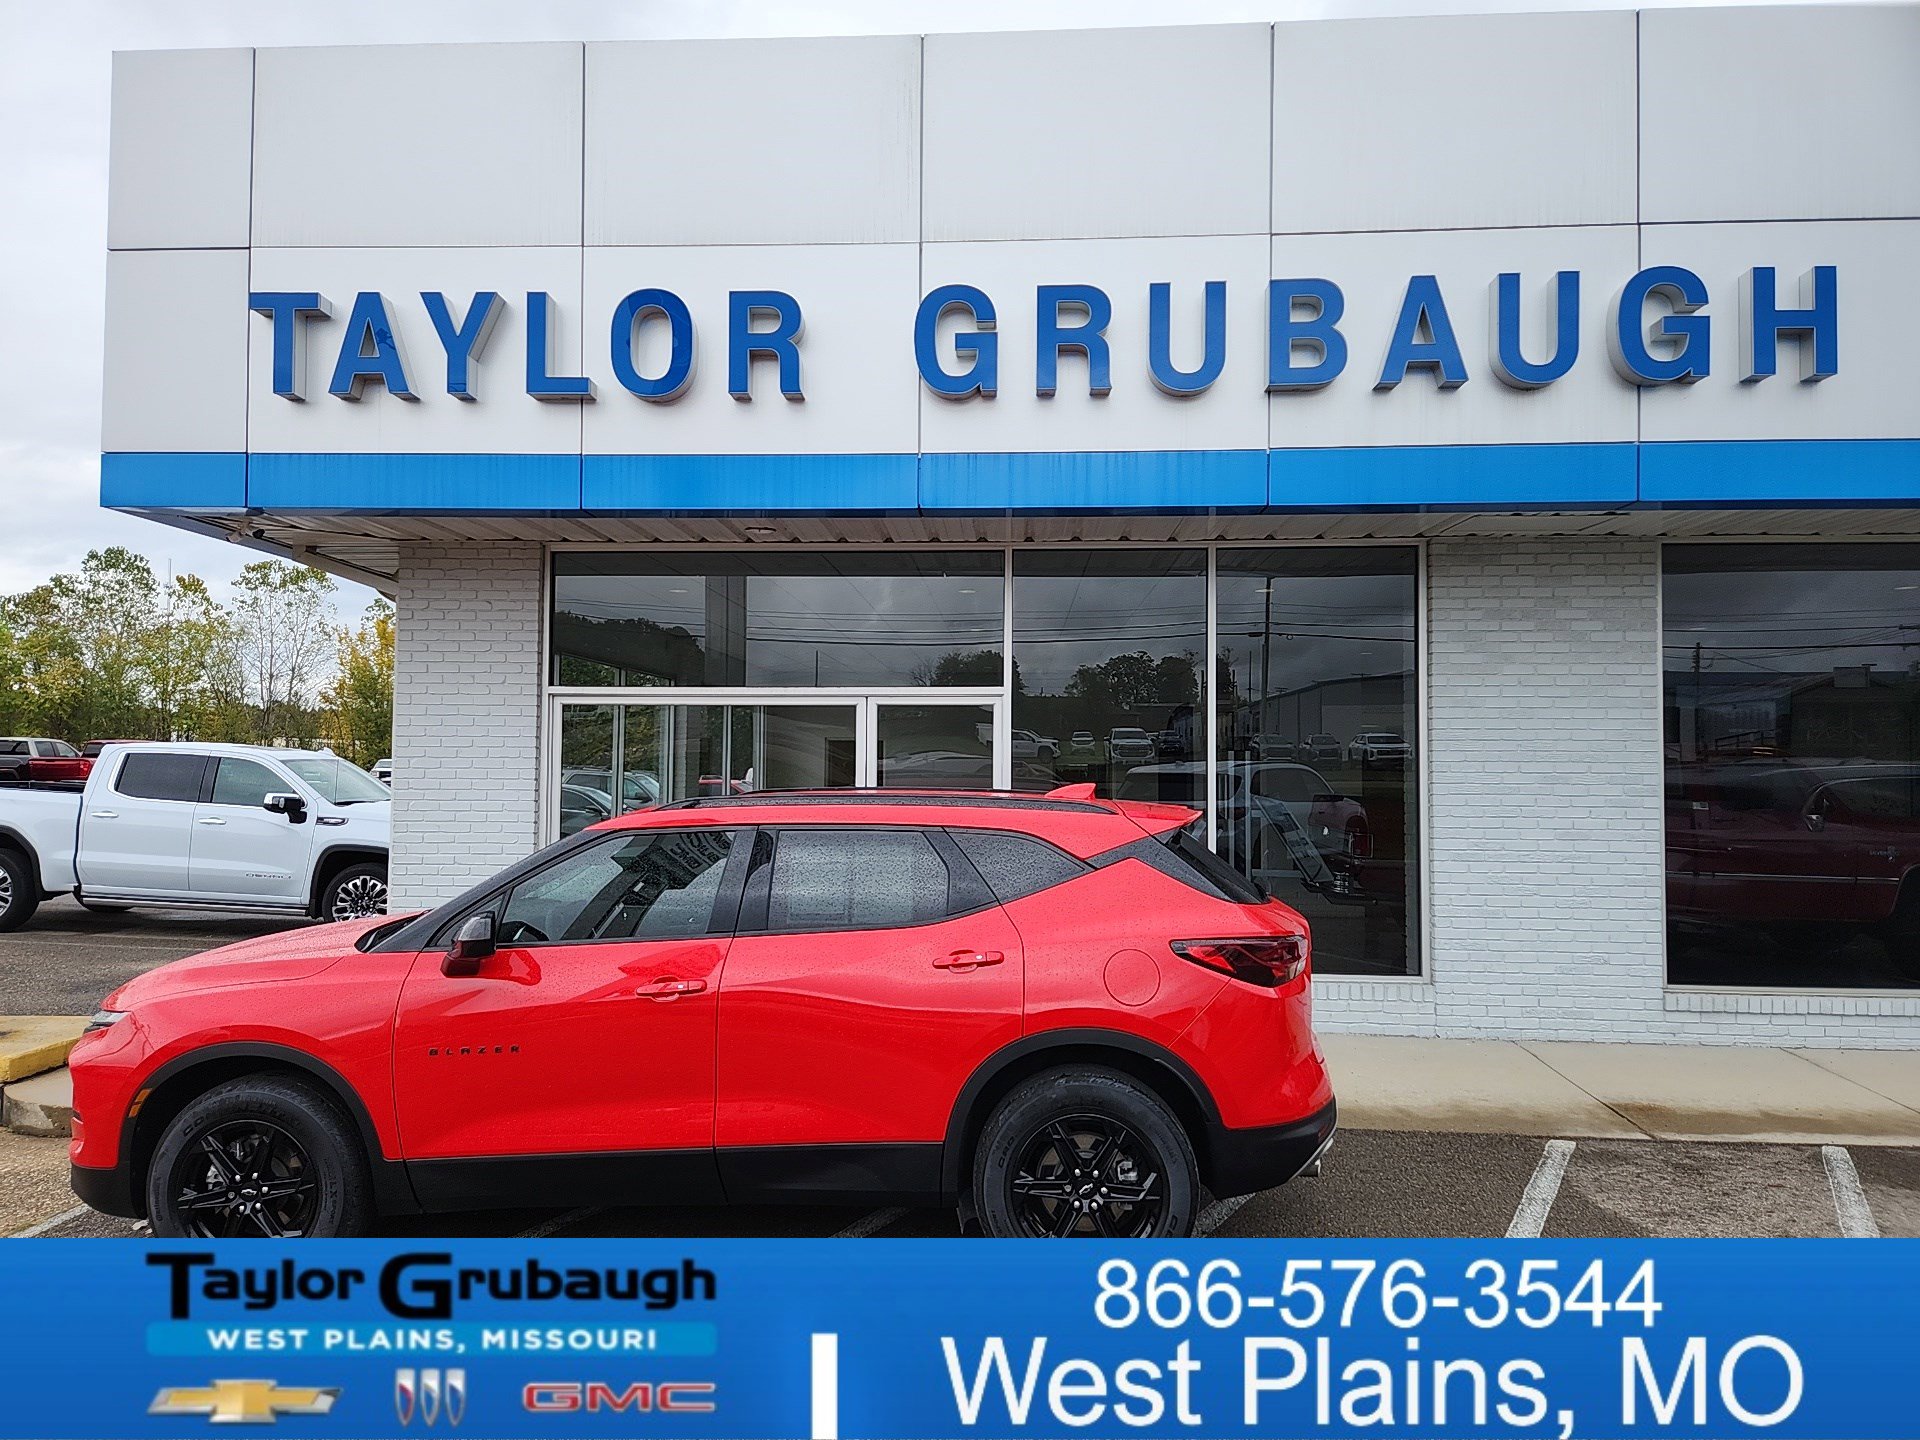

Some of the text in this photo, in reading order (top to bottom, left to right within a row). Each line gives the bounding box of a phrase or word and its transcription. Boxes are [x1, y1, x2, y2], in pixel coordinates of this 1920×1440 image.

[249, 265, 1840, 404] TAYLOR GRUBAUGH
[428, 1045, 521, 1057] BLAZER
